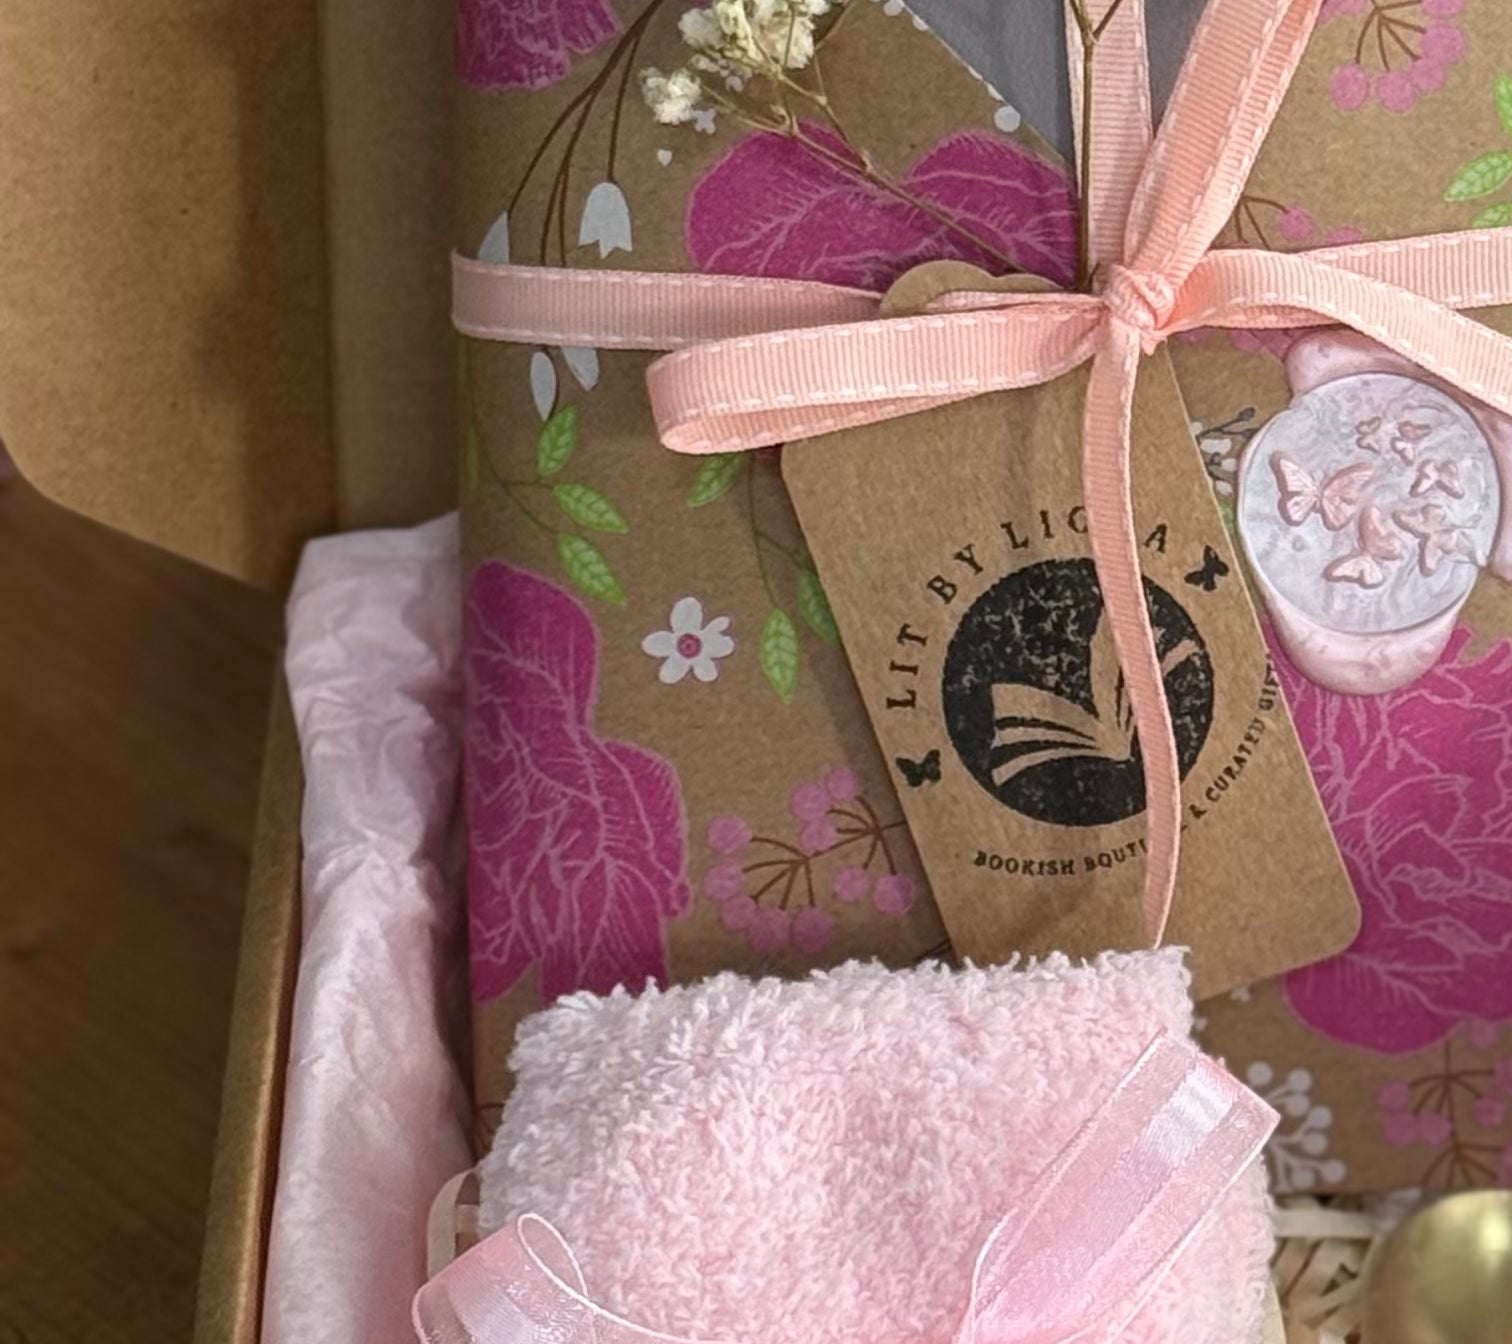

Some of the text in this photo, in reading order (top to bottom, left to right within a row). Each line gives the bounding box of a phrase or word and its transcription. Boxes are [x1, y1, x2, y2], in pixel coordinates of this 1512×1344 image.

[886, 506, 1168, 710] LIT BY LIOA
[973, 850, 1075, 877] BOOKISH
[1205, 717, 1266, 804] CURATED
